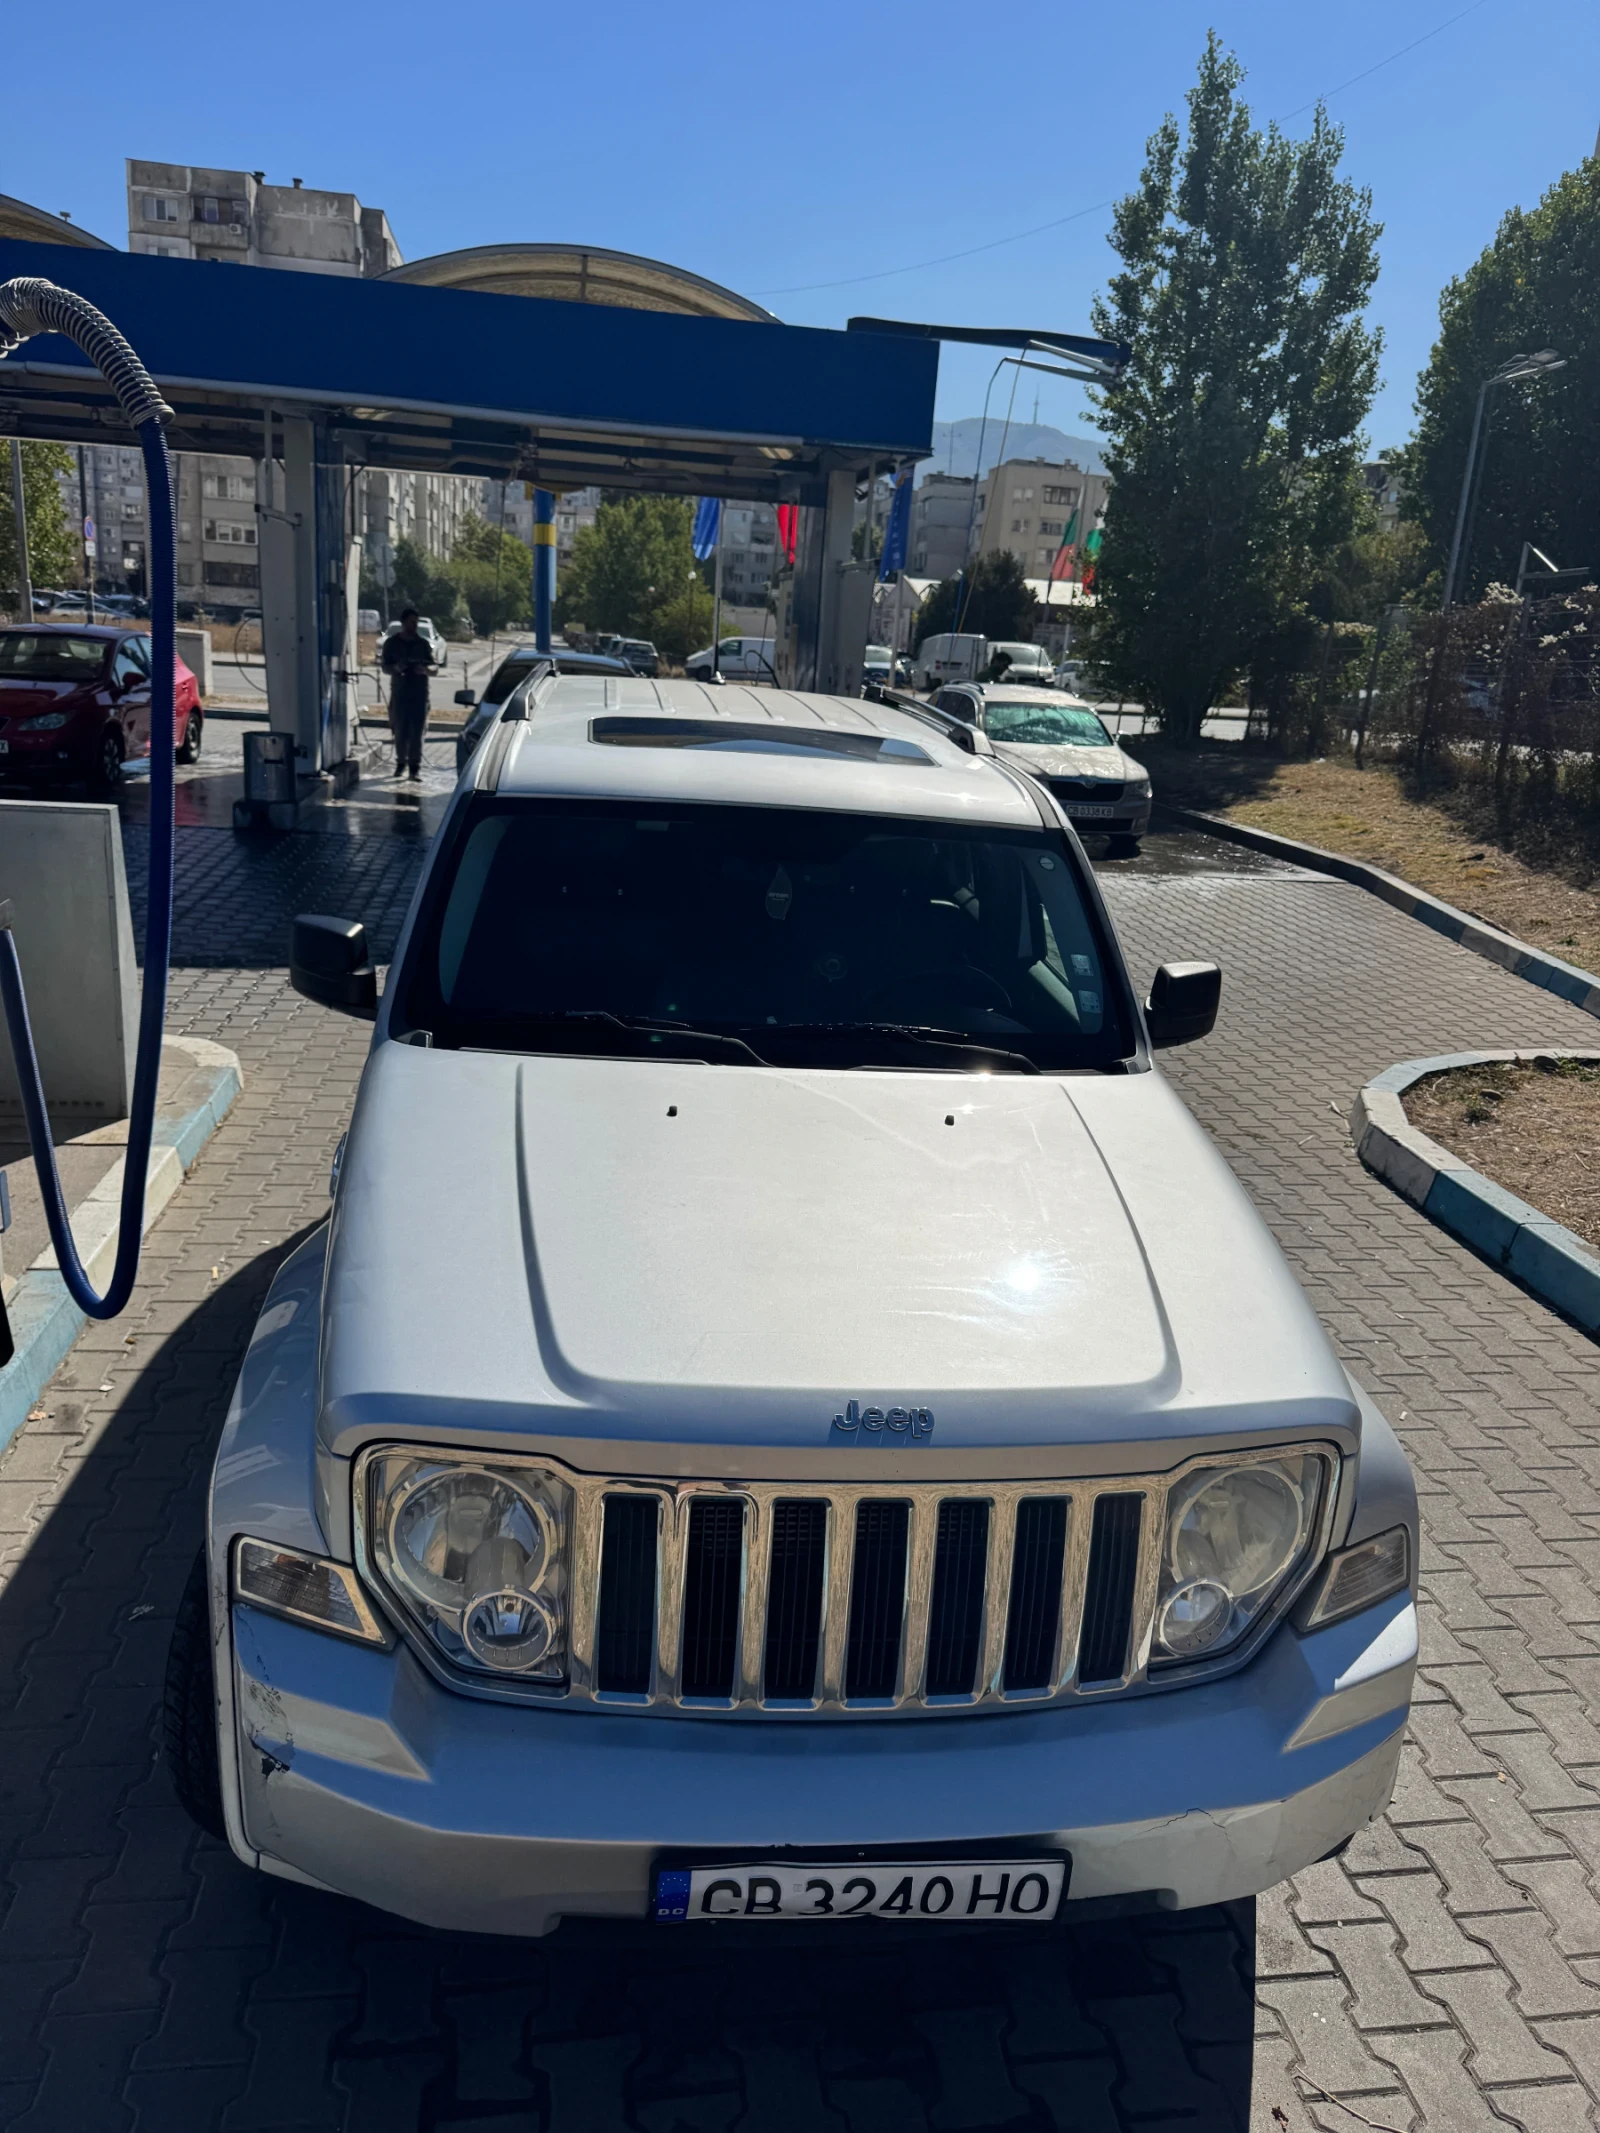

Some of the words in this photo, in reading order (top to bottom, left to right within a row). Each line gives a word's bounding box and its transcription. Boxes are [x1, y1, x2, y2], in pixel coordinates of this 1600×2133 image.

[834, 1398, 935, 1438] Jeep
[701, 1875, 782, 1915] CB
[797, 1875, 954, 1916] 3240
[965, 1873, 1051, 1915] HO
